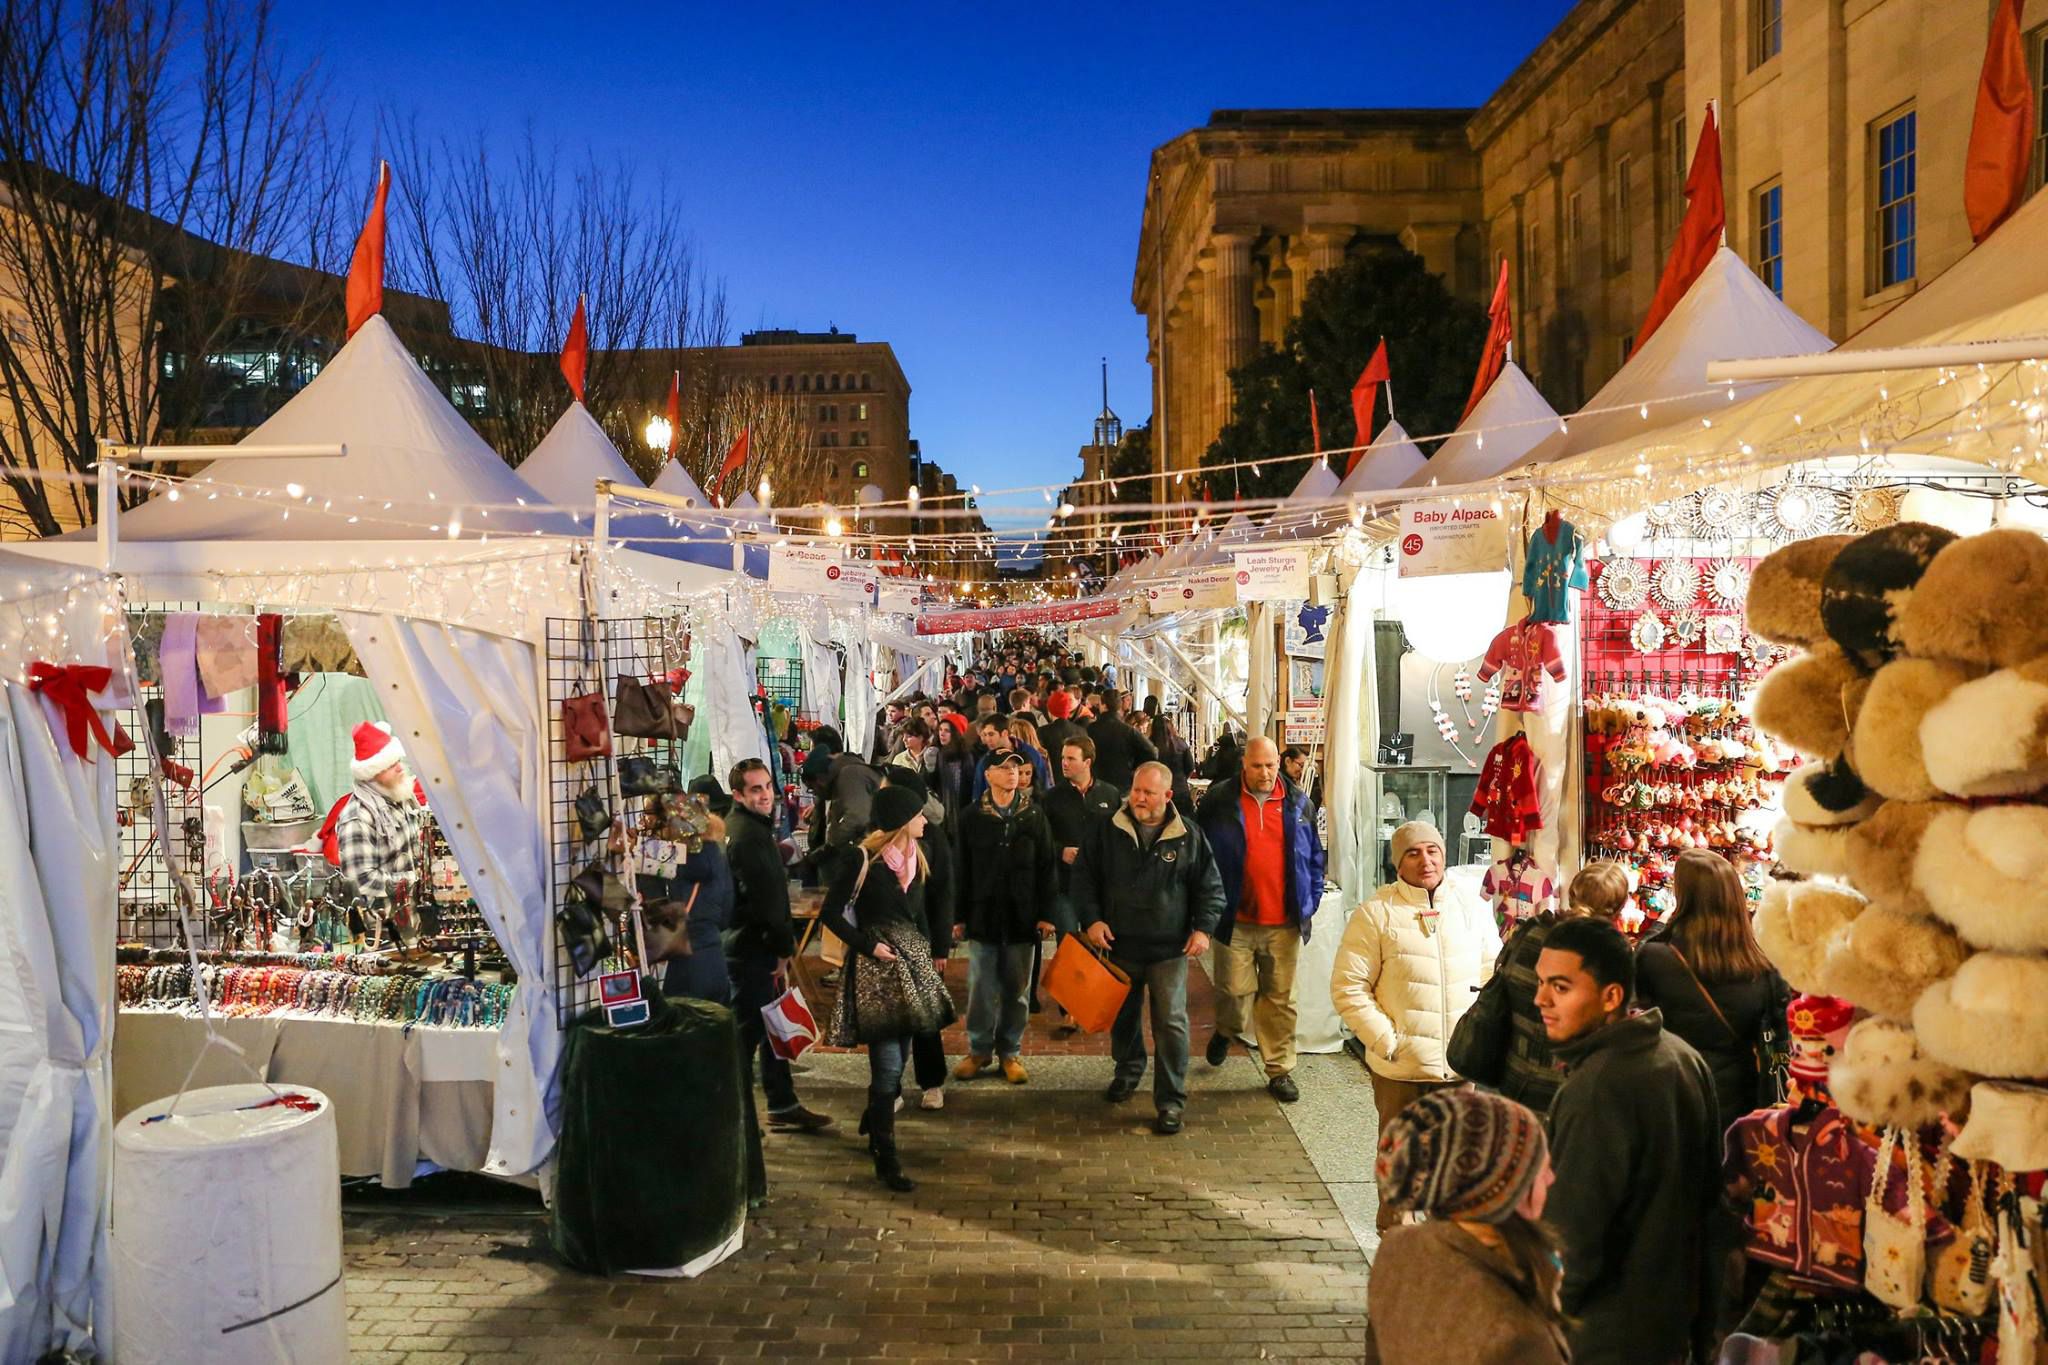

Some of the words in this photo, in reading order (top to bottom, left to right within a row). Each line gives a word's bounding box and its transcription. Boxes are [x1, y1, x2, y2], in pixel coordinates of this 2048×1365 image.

[1414, 511, 1448, 524] Baby
[1451, 509, 1497, 522] Alpaca
[1404, 538, 1421, 552] 45
[1247, 557, 1267, 565] Leah
[1268, 556, 1296, 565] Sturgis
[828, 568, 838, 578] 61
[1249, 565, 1281, 573] Jewelry
[1282, 564, 1295, 572] Art
[1188, 577, 1210, 585] Naked
[1183, 589, 1194, 598] 43
[981, 611, 1021, 620] WELCOME
